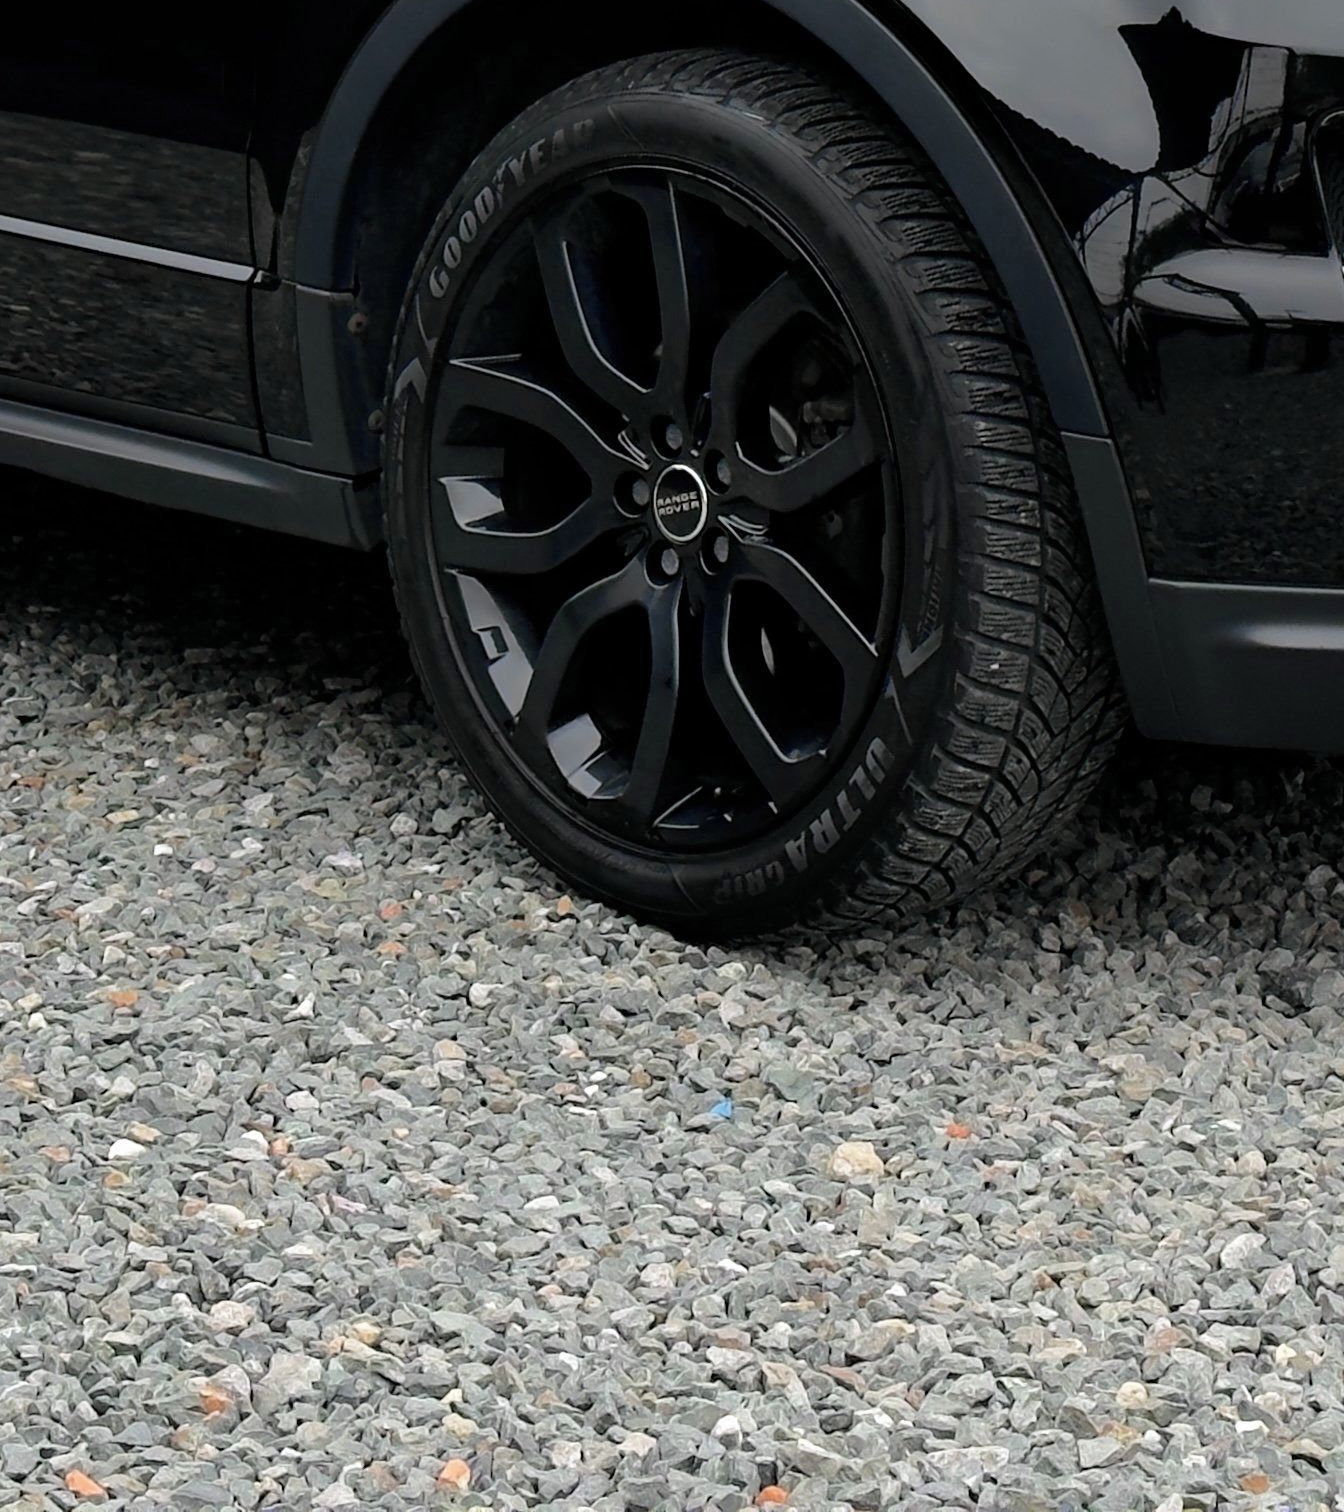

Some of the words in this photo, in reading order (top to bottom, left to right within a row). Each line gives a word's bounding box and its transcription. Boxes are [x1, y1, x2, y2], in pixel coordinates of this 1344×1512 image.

[427, 116, 596, 300] GOODYEAR
[656, 490, 699, 508] RANGE
[657, 500, 700, 516] ROVER
[784, 735, 896, 874] ULTRA
